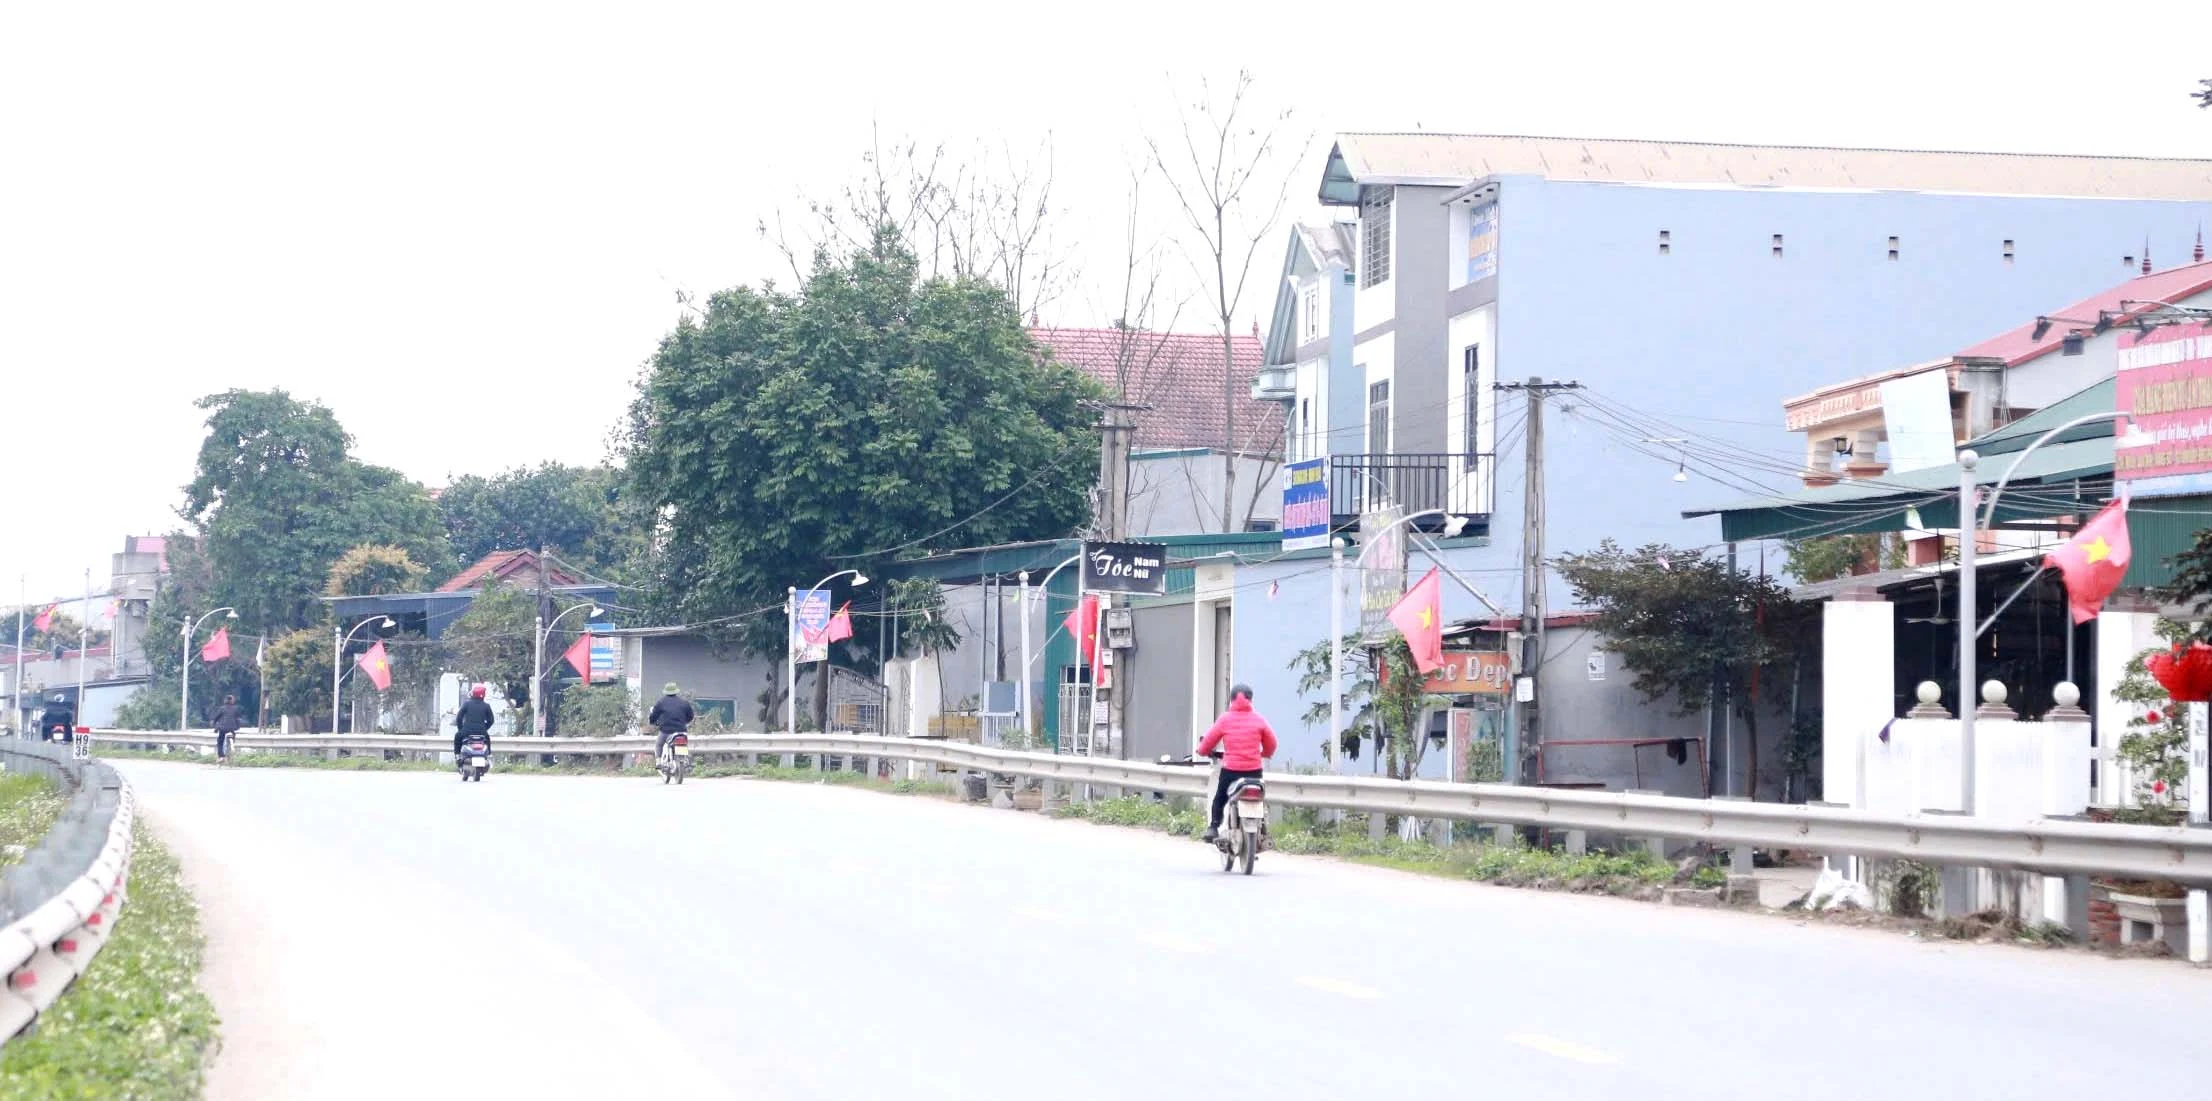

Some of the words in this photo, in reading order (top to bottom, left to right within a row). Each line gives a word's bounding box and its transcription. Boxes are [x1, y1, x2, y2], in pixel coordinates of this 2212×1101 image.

[1095, 555, 1133, 577] Tóc
[1134, 557, 1160, 567] Nam
[75, 734, 89, 745] H9
